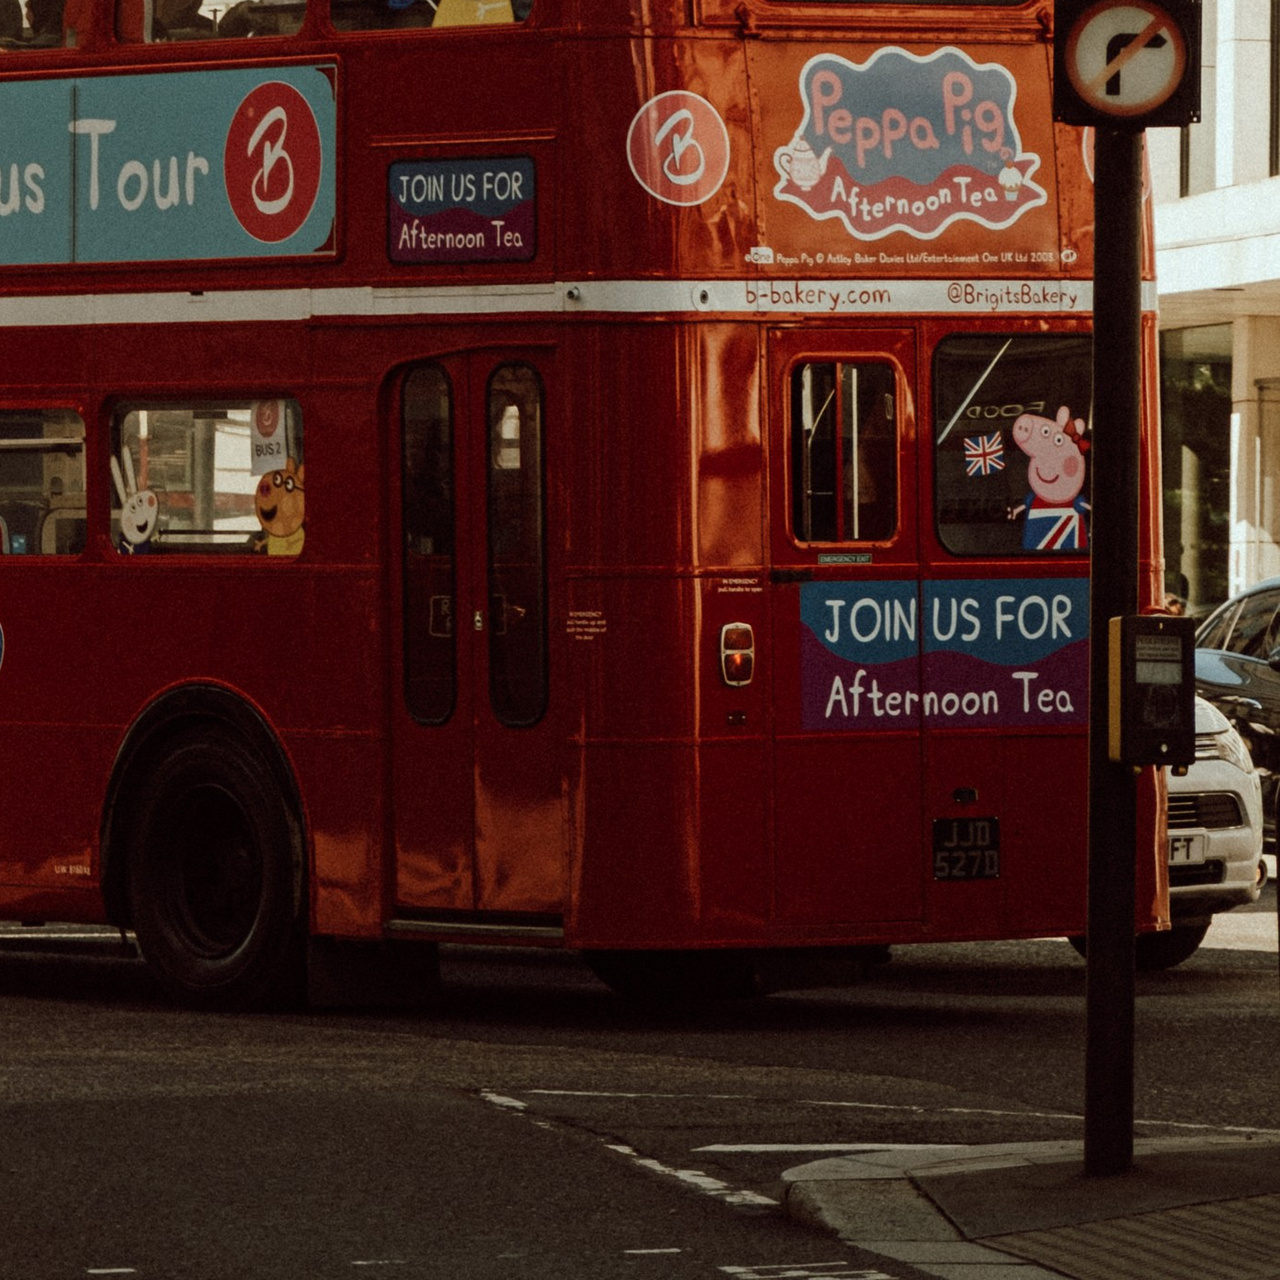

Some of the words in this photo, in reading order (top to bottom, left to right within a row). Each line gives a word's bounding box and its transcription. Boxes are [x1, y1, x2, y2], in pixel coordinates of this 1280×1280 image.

[811, 69, 940, 169] Peppa
[942, 71, 1011, 158] Pig
[69, 118, 210, 212] Tour
[247, 106, 294, 216] B
[655, 108, 706, 187] B
[399, 174, 444, 203] JOIN
[452, 173, 476, 202] US
[483, 171, 523, 201] FOR
[831, 176, 951, 222] Afternoon
[953, 177, 999, 208] Tea
[398, 219, 485, 250] Afternoon
[491, 220, 523, 247] Tea
[777, 253, 799, 267] Peppa
[801, 253, 814, 267] Pig
[854, 252, 877, 264] Baker
[982, 252, 998, 263] One
[1001, 252, 1013, 262] UK
[1015, 252, 1028, 263] Ltd
[745, 281, 891, 311] b-bakery.com
[947, 282, 1078, 311] @BrigitsBakery
[255, 443, 274, 457] BUS
[276, 442, 282, 455] 2
[825, 597, 916, 642] JOIN
[933, 597, 981, 641] US
[995, 594, 1072, 640] FOR
[825, 669, 998, 718] Afternoon
[1011, 671, 1074, 713] Tea
